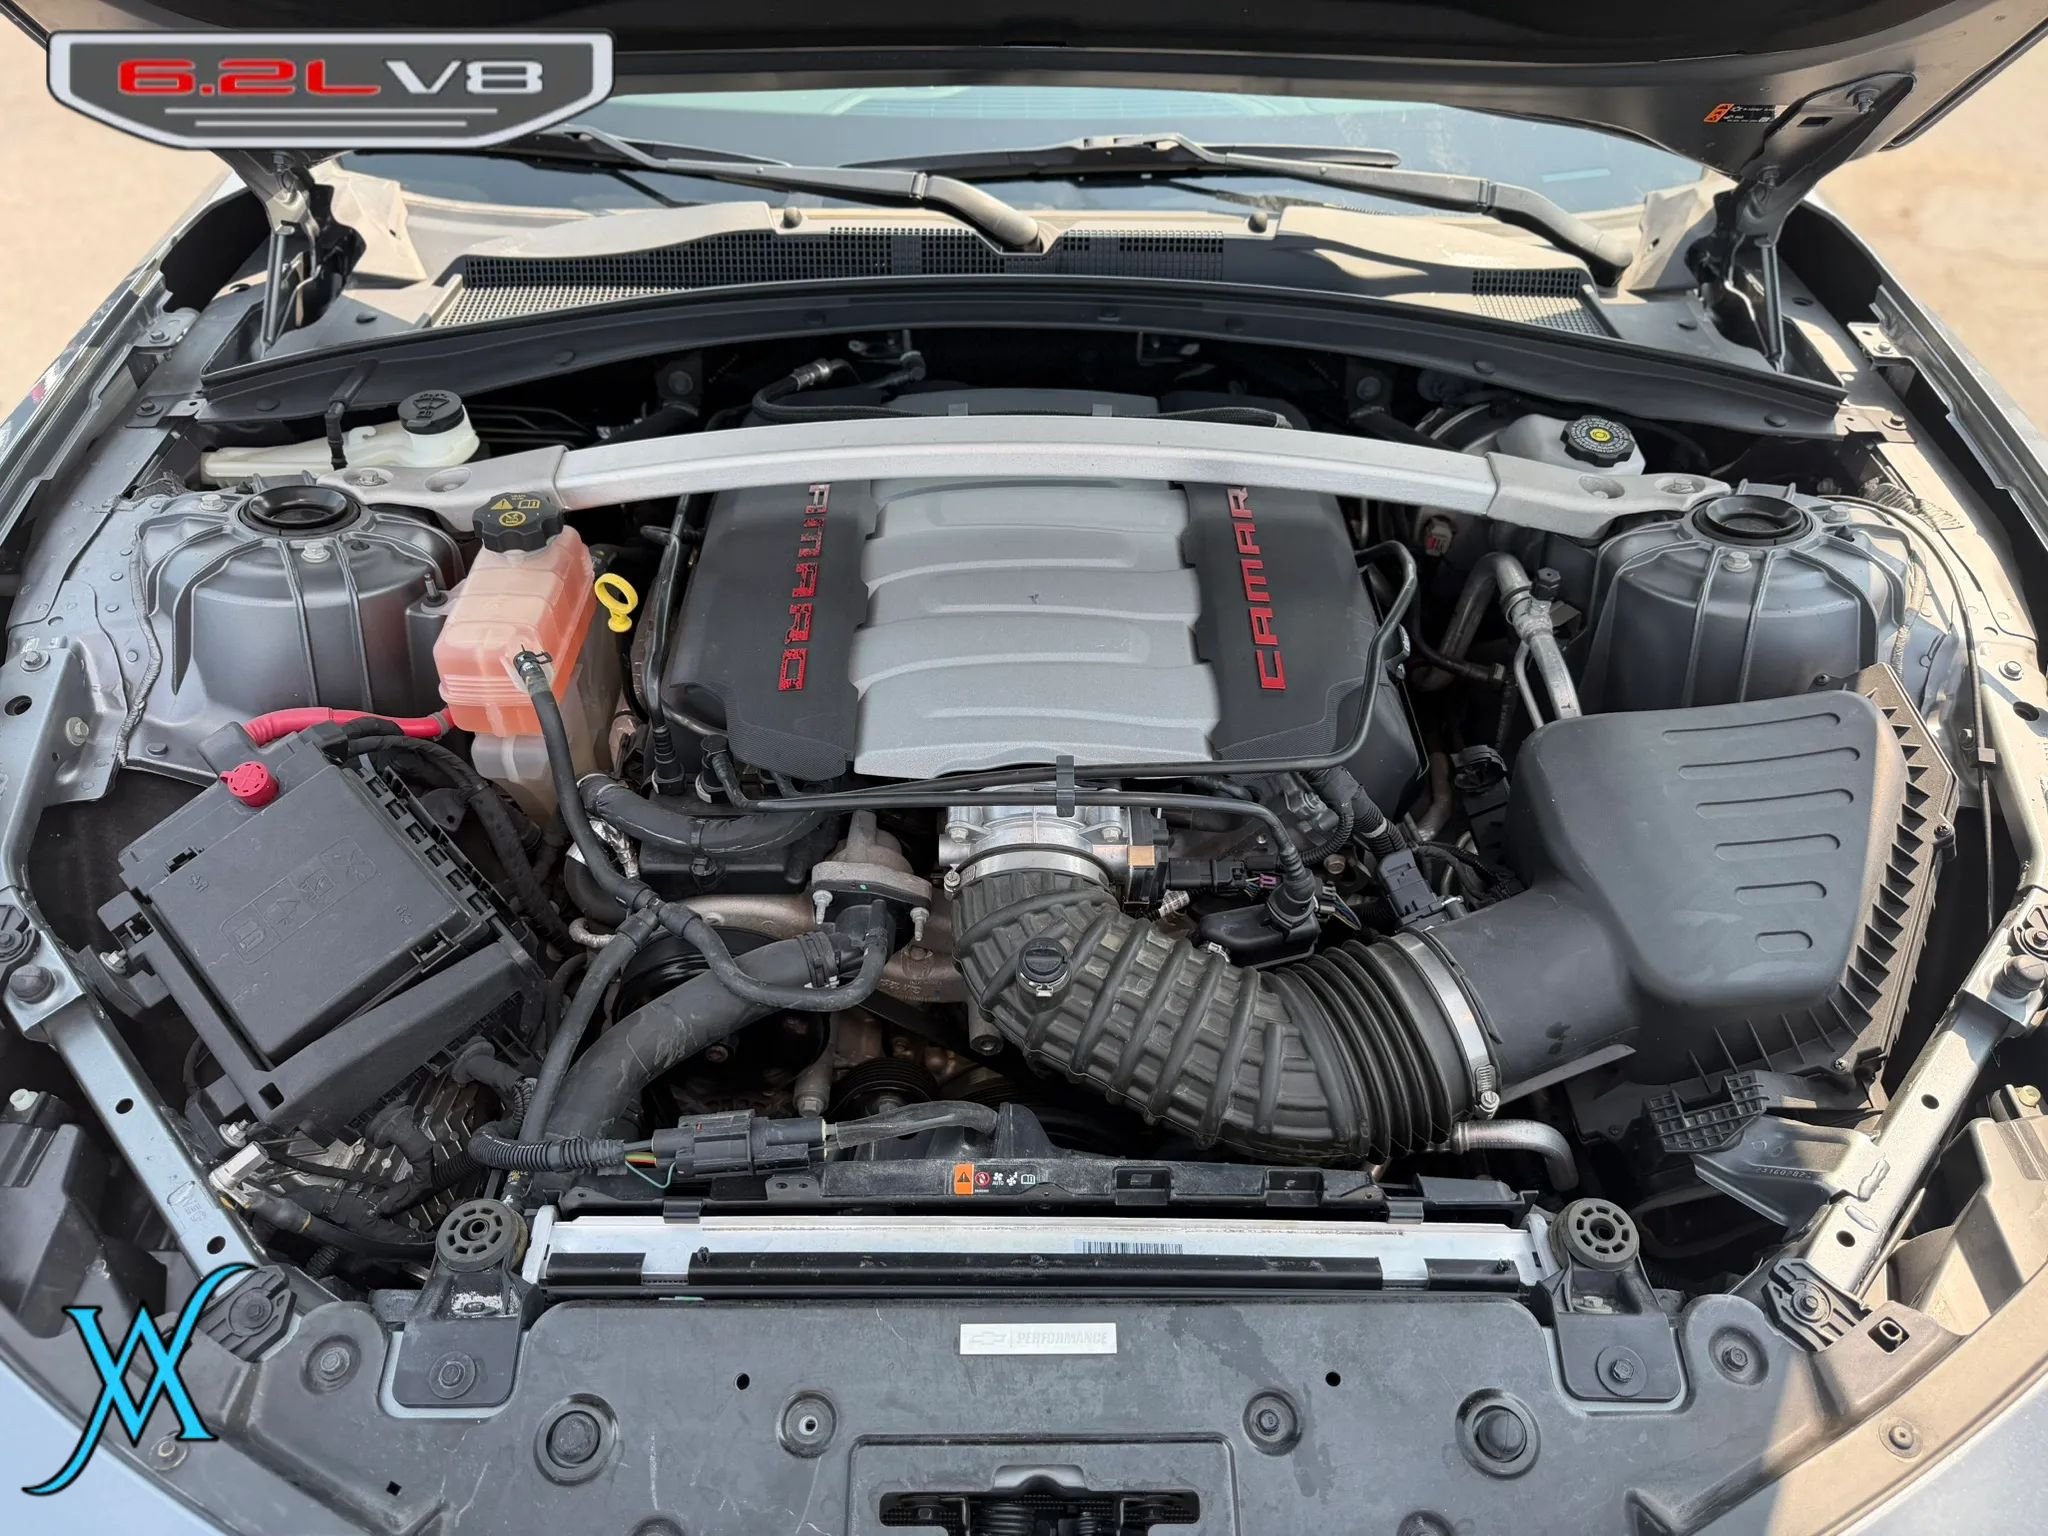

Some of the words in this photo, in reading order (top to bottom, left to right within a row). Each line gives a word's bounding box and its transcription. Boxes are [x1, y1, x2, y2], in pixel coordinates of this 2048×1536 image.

[778, 483, 831, 691] AMARO
[1227, 487, 1286, 689] CAMAR
[1016, 1331, 1108, 1345] PERFORMANCE
